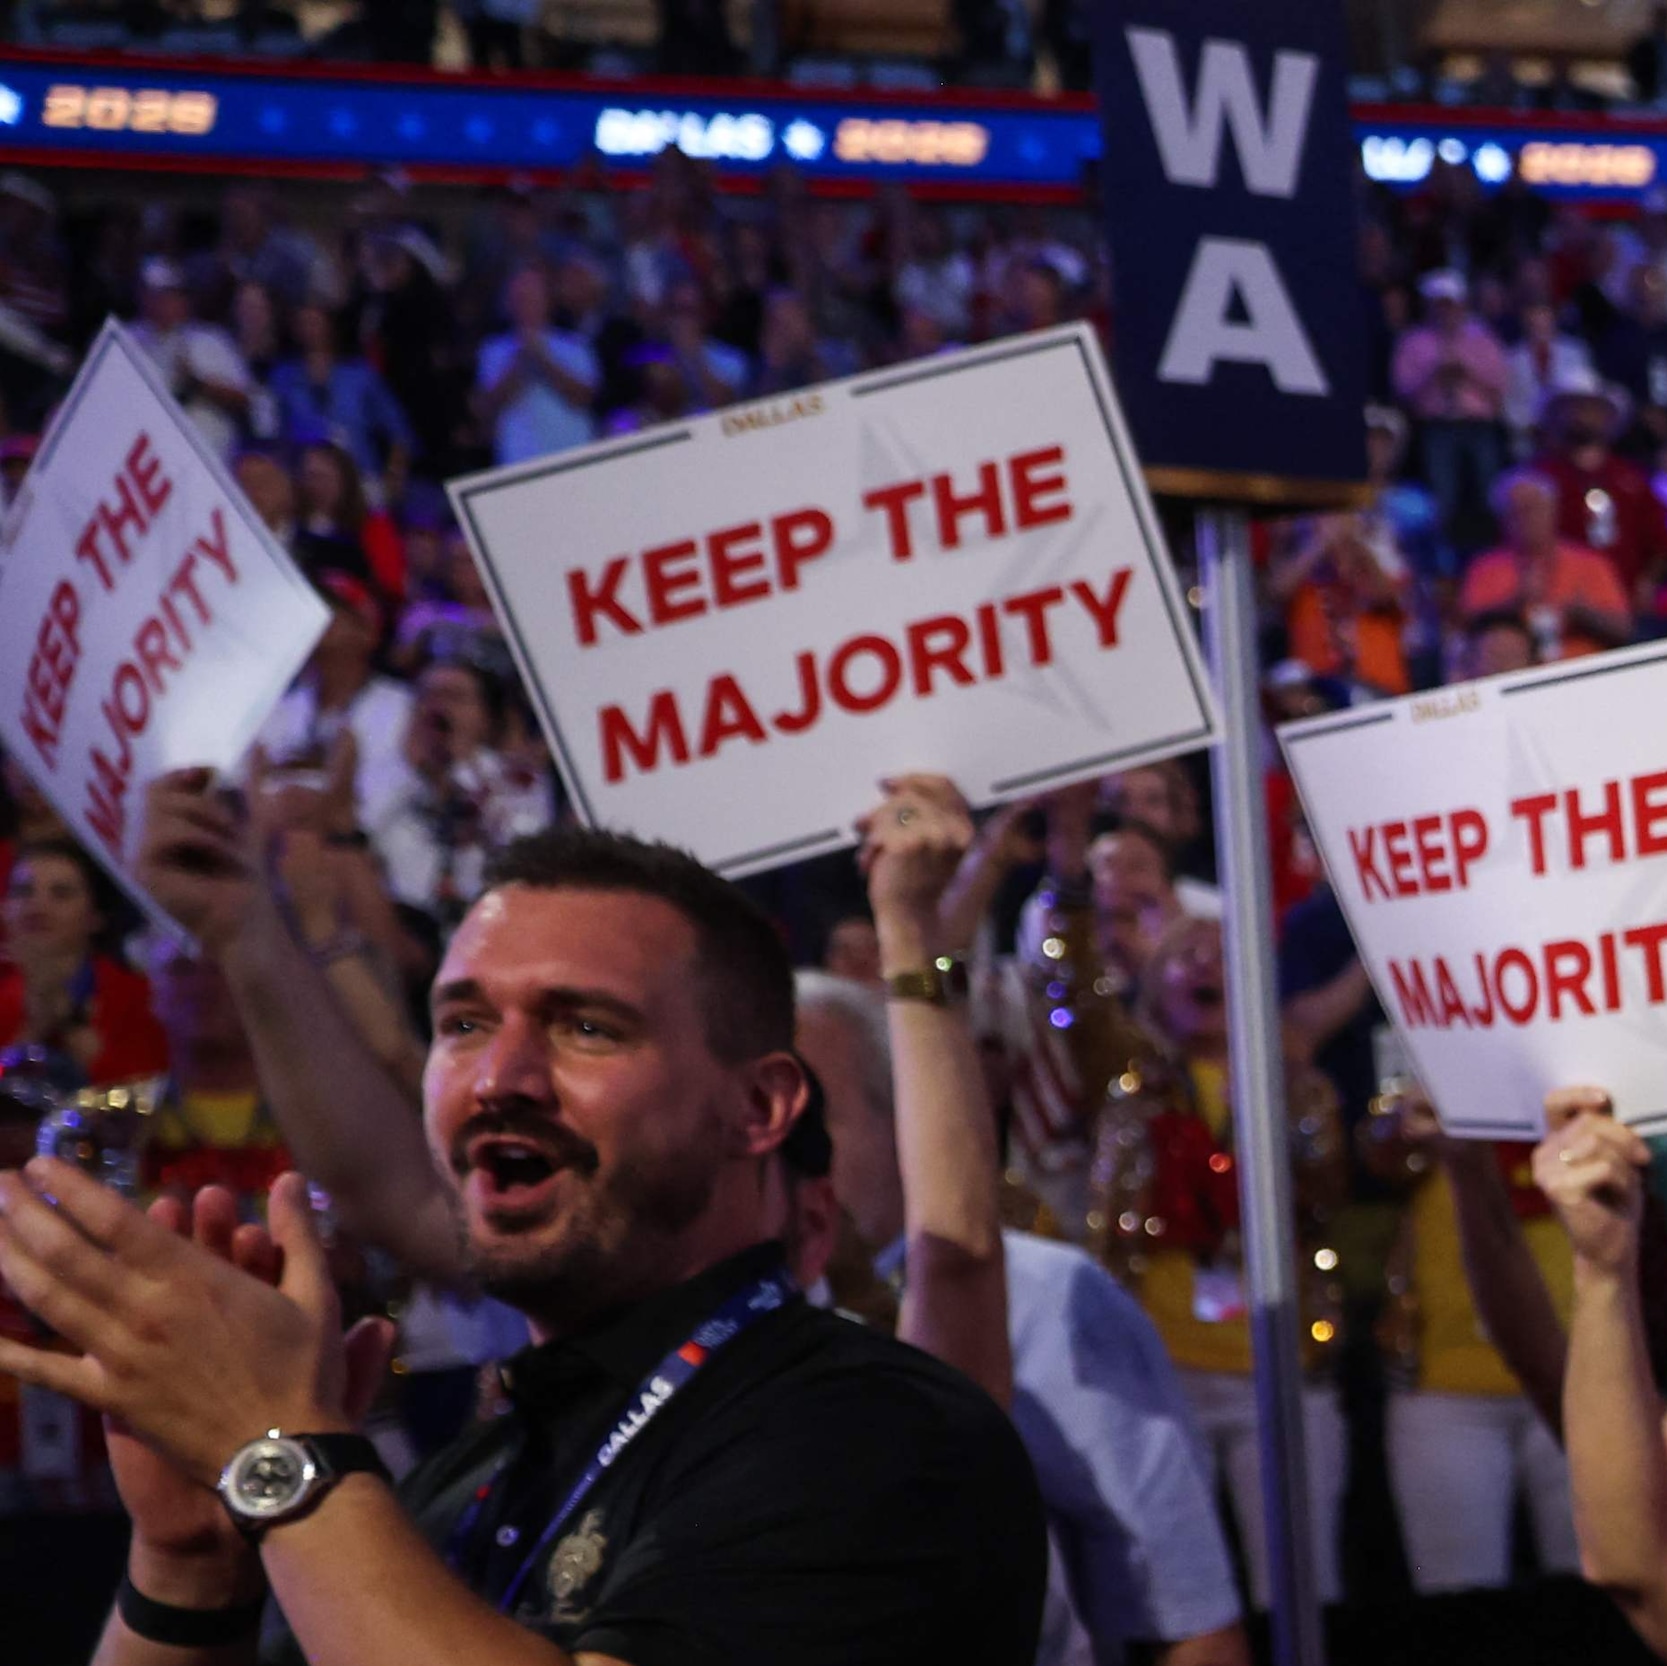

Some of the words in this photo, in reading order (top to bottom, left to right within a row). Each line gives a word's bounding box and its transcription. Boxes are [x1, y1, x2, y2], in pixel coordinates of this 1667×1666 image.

[20, 579, 82, 770] KEEP
[75, 431, 173, 591] THE
[565, 508, 834, 647] KEEP
[864, 444, 1073, 562] THE
[83, 509, 240, 860] MAJORITY
[599, 566, 1133, 783] MAJORITY
[1347, 808, 1488, 902] KEEP
[597, 1375, 675, 1467] DALLAS
